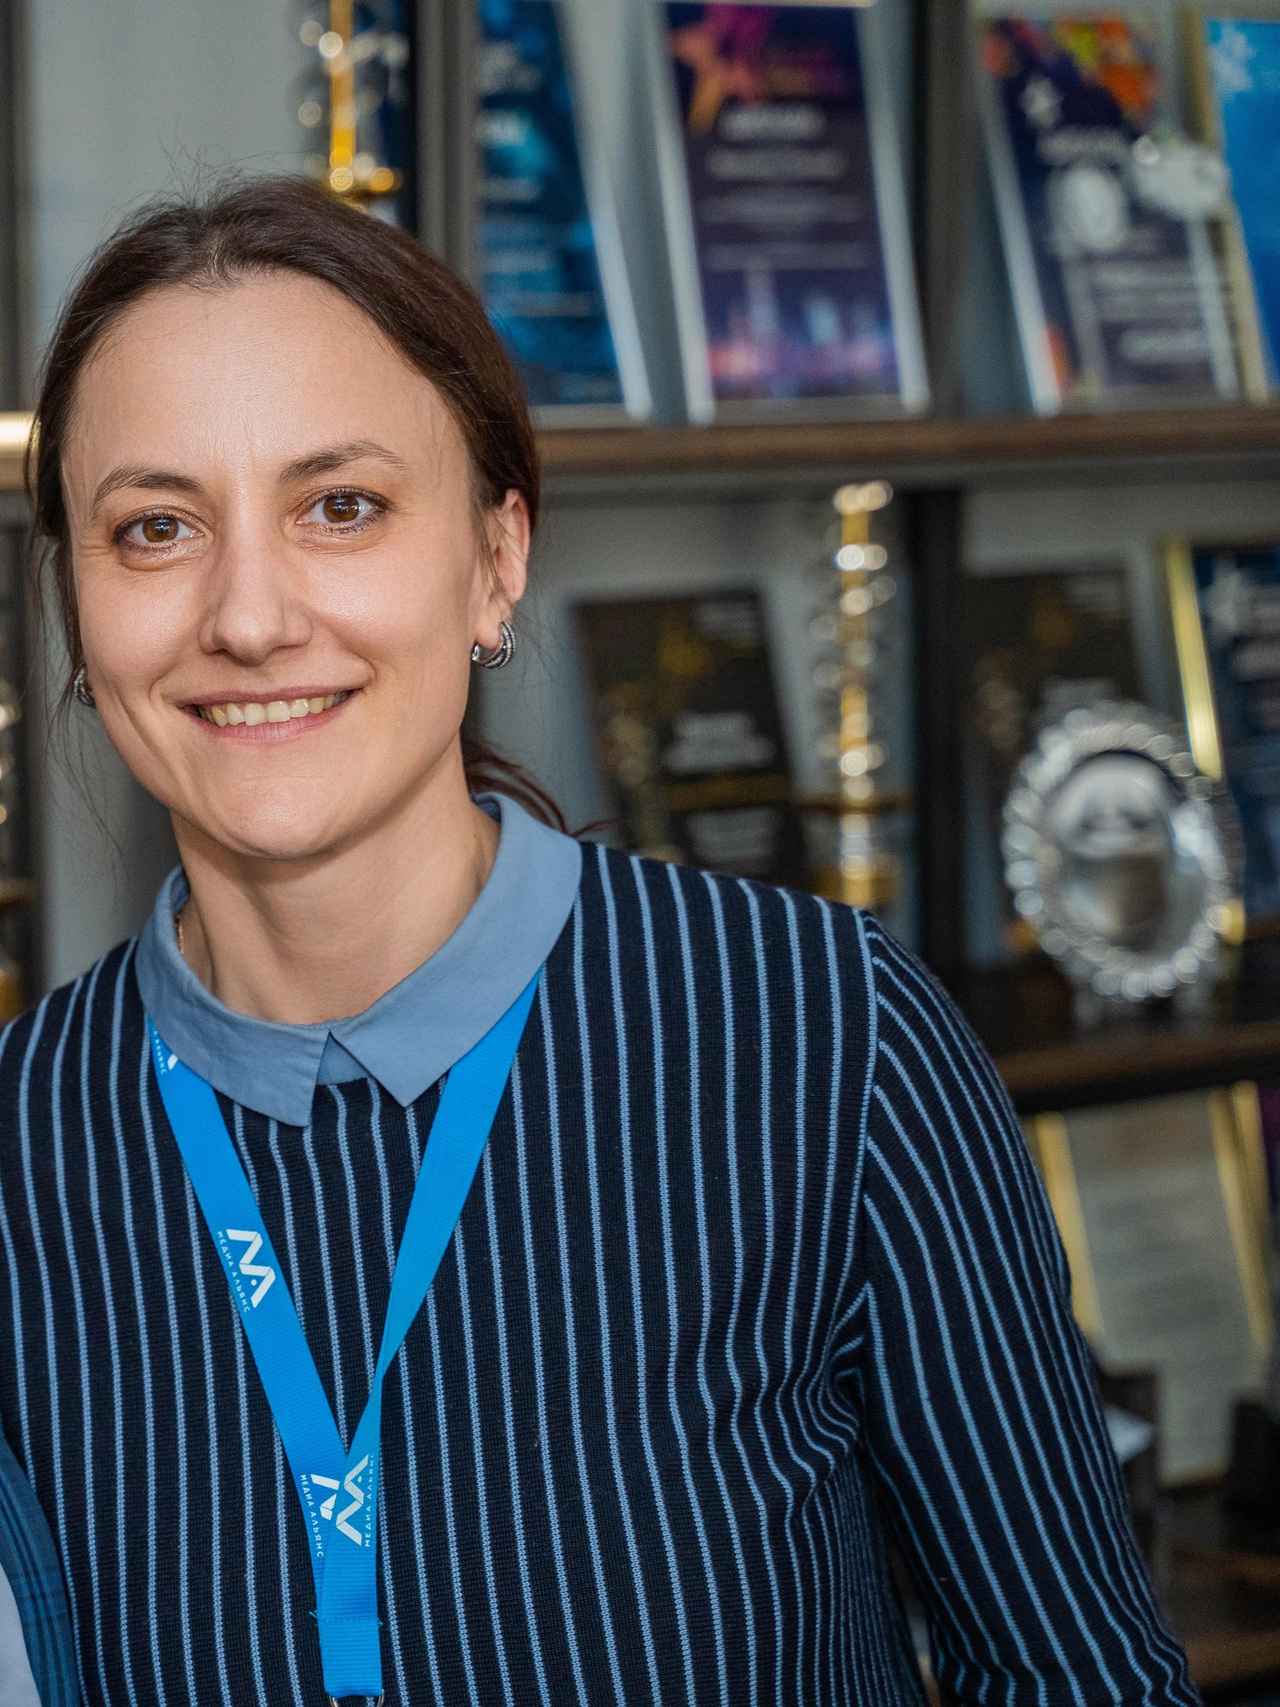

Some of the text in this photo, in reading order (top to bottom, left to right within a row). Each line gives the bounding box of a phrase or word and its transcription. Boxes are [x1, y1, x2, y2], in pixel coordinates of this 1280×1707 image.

[217, 1231, 250, 1312] МЕДИА АЛЬЯНС
[300, 1474, 324, 1558] МЕДИА АЛЬЯНС
